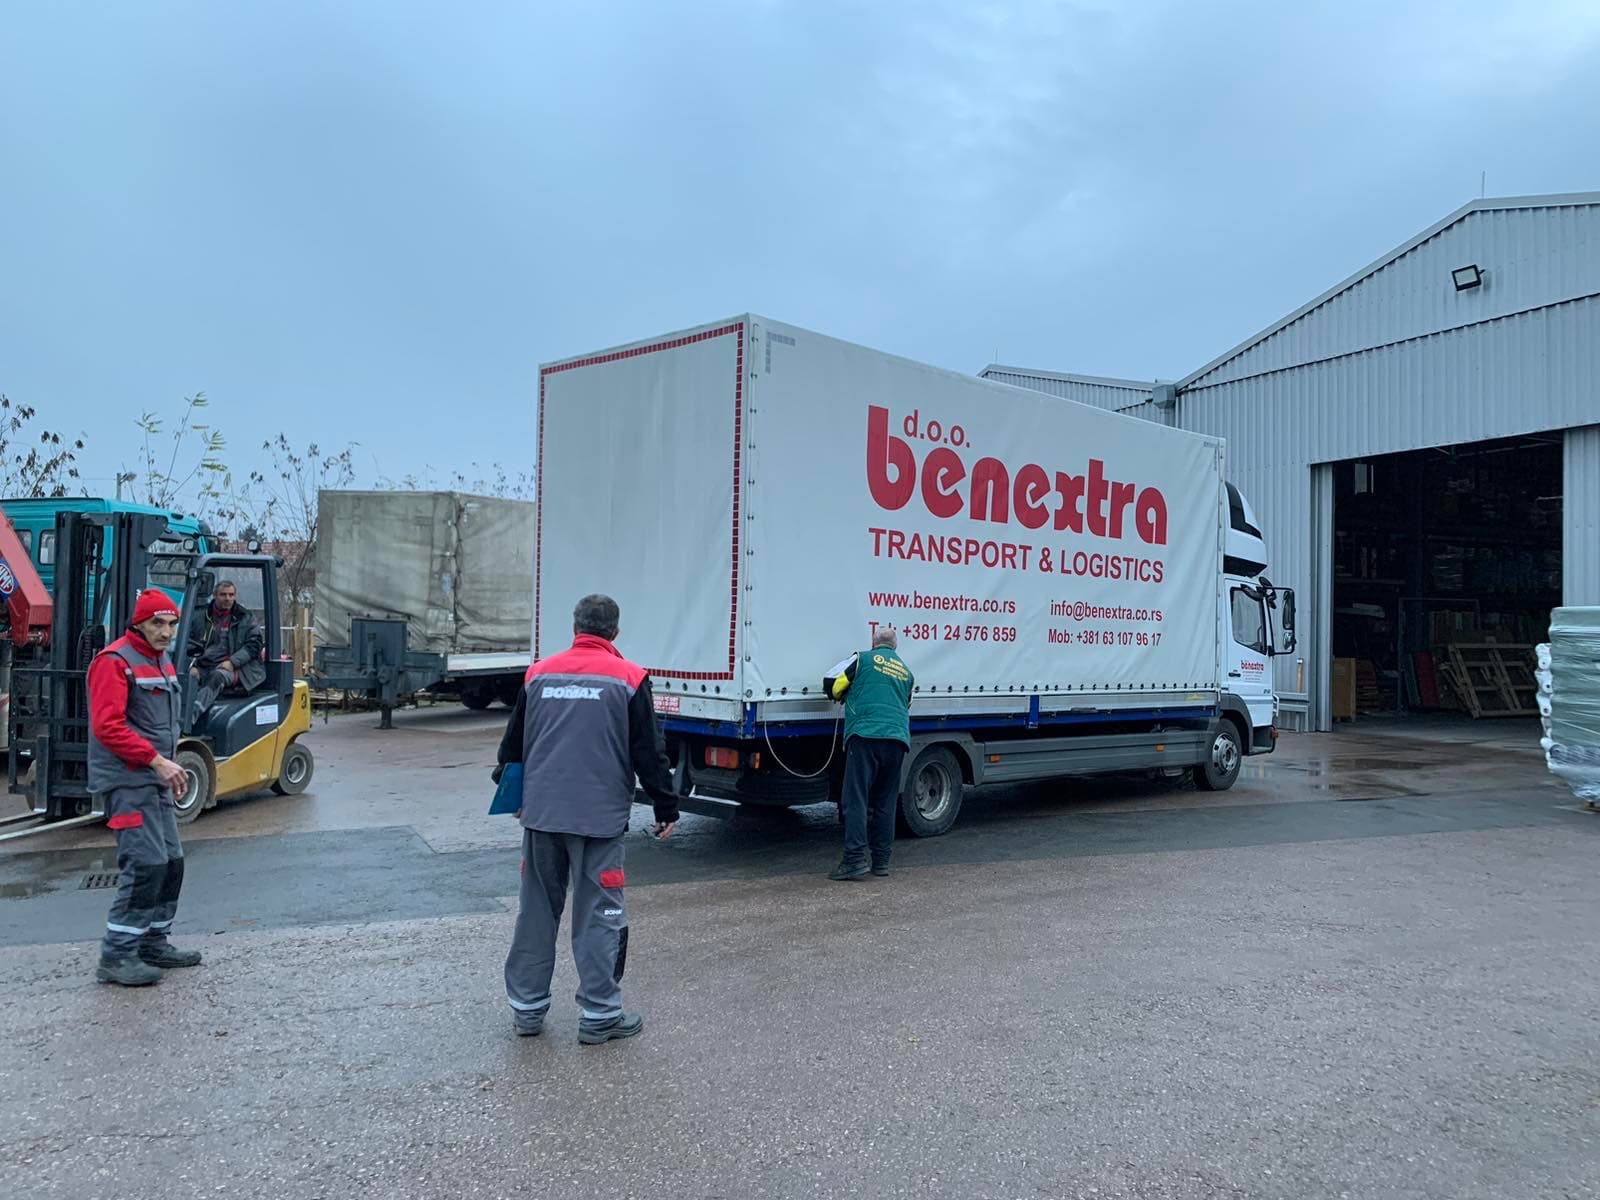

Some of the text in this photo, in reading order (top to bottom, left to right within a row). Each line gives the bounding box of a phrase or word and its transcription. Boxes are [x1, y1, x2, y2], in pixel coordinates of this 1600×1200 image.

[903, 409, 971, 449] d.o.o.
[866, 404, 1168, 546] benextra
[868, 527, 1164, 584] TRANSPORT & LOGISTICS
[868, 590, 1016, 614] www.benextra.co.rs
[1050, 599, 1163, 622] info@benextra.co.rs
[902, 623, 937, 641] +381
[943, 624, 961, 641] 24
[964, 625, 988, 642] 576
[992, 626, 1017, 642] 859
[1048, 628, 1162, 646] Mob: +381 63 107 96 17
[541, 685, 604, 700] BOMAX
